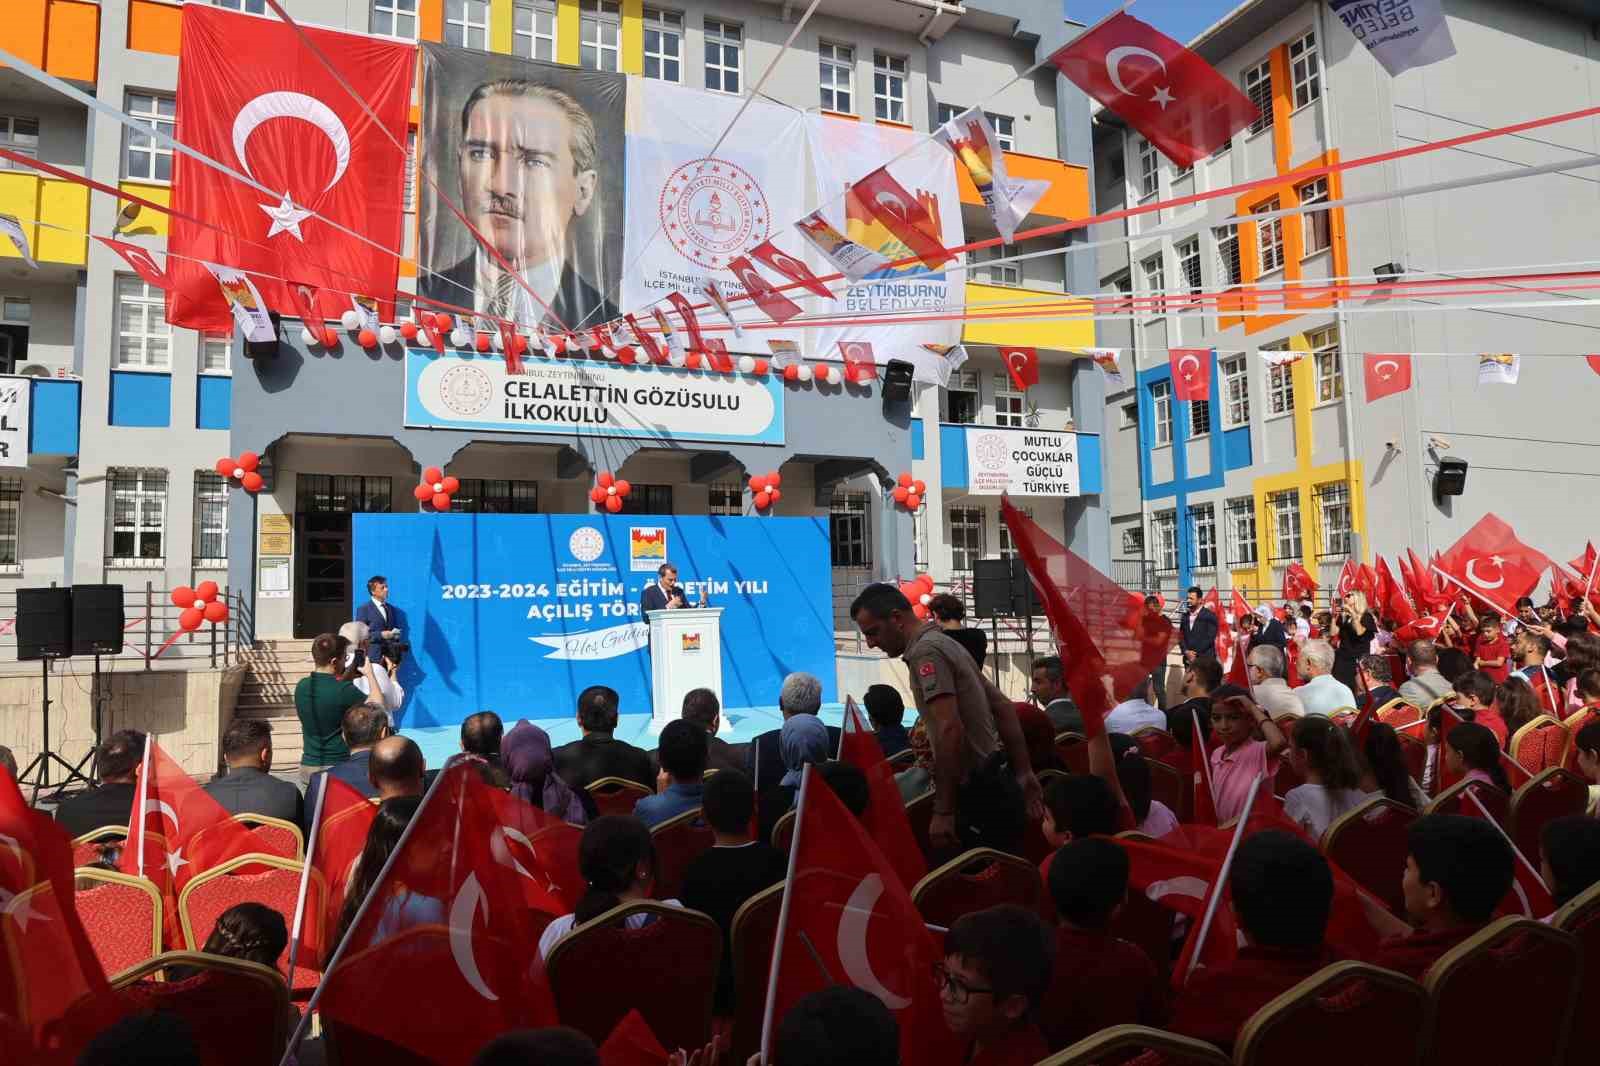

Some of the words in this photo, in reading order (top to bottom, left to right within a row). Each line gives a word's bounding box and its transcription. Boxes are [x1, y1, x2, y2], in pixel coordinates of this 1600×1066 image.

[847, 283, 947, 299] ZEYTİNBURNU
[504, 380, 628, 405] CELALETTİN
[633, 386, 740, 411] GÖZÜSULU
[504, 398, 608, 424] İLKOKULU
[1024, 436, 1062, 448] MUTLU
[1012, 450, 1073, 464] ÇOCUKLAR
[1026, 463, 1063, 480] GÜÇLÜ
[1023, 479, 1070, 494] TÜRKİYE
[441, 583, 550, 600] 2023-2024
[556, 578, 624, 597] EĞİTİM
[730, 580, 768, 594] YILI
[527, 602, 593, 622] AÇILIŞ
